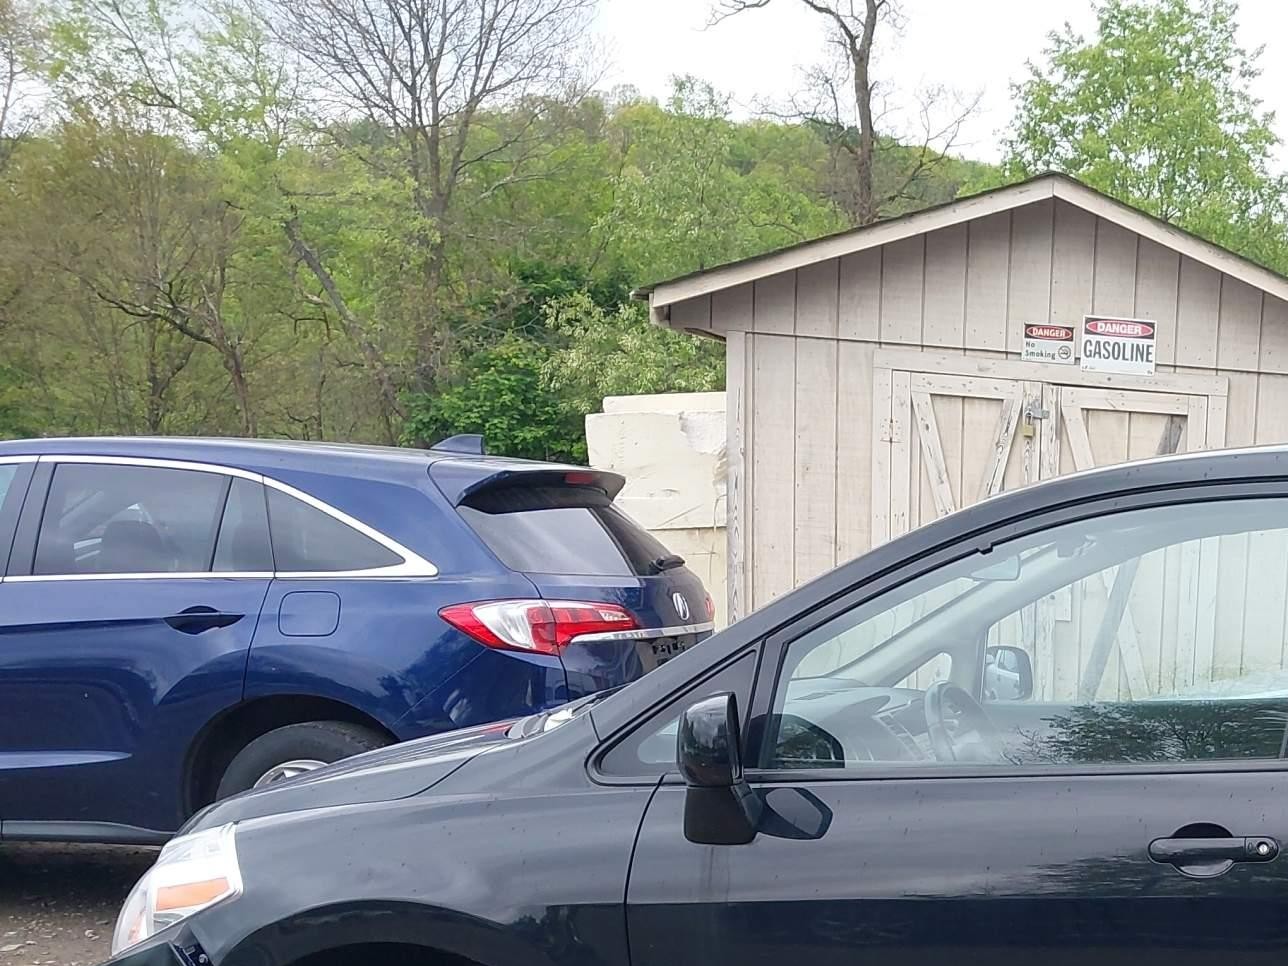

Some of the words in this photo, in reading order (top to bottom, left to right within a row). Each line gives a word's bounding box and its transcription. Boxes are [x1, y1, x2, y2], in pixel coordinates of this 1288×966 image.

[1032, 328, 1066, 338] DANGER
[1096, 322, 1142, 335] DANGER
[1025, 349, 1056, 360] Smoking
[1083, 339, 1154, 363] GASOLINE
